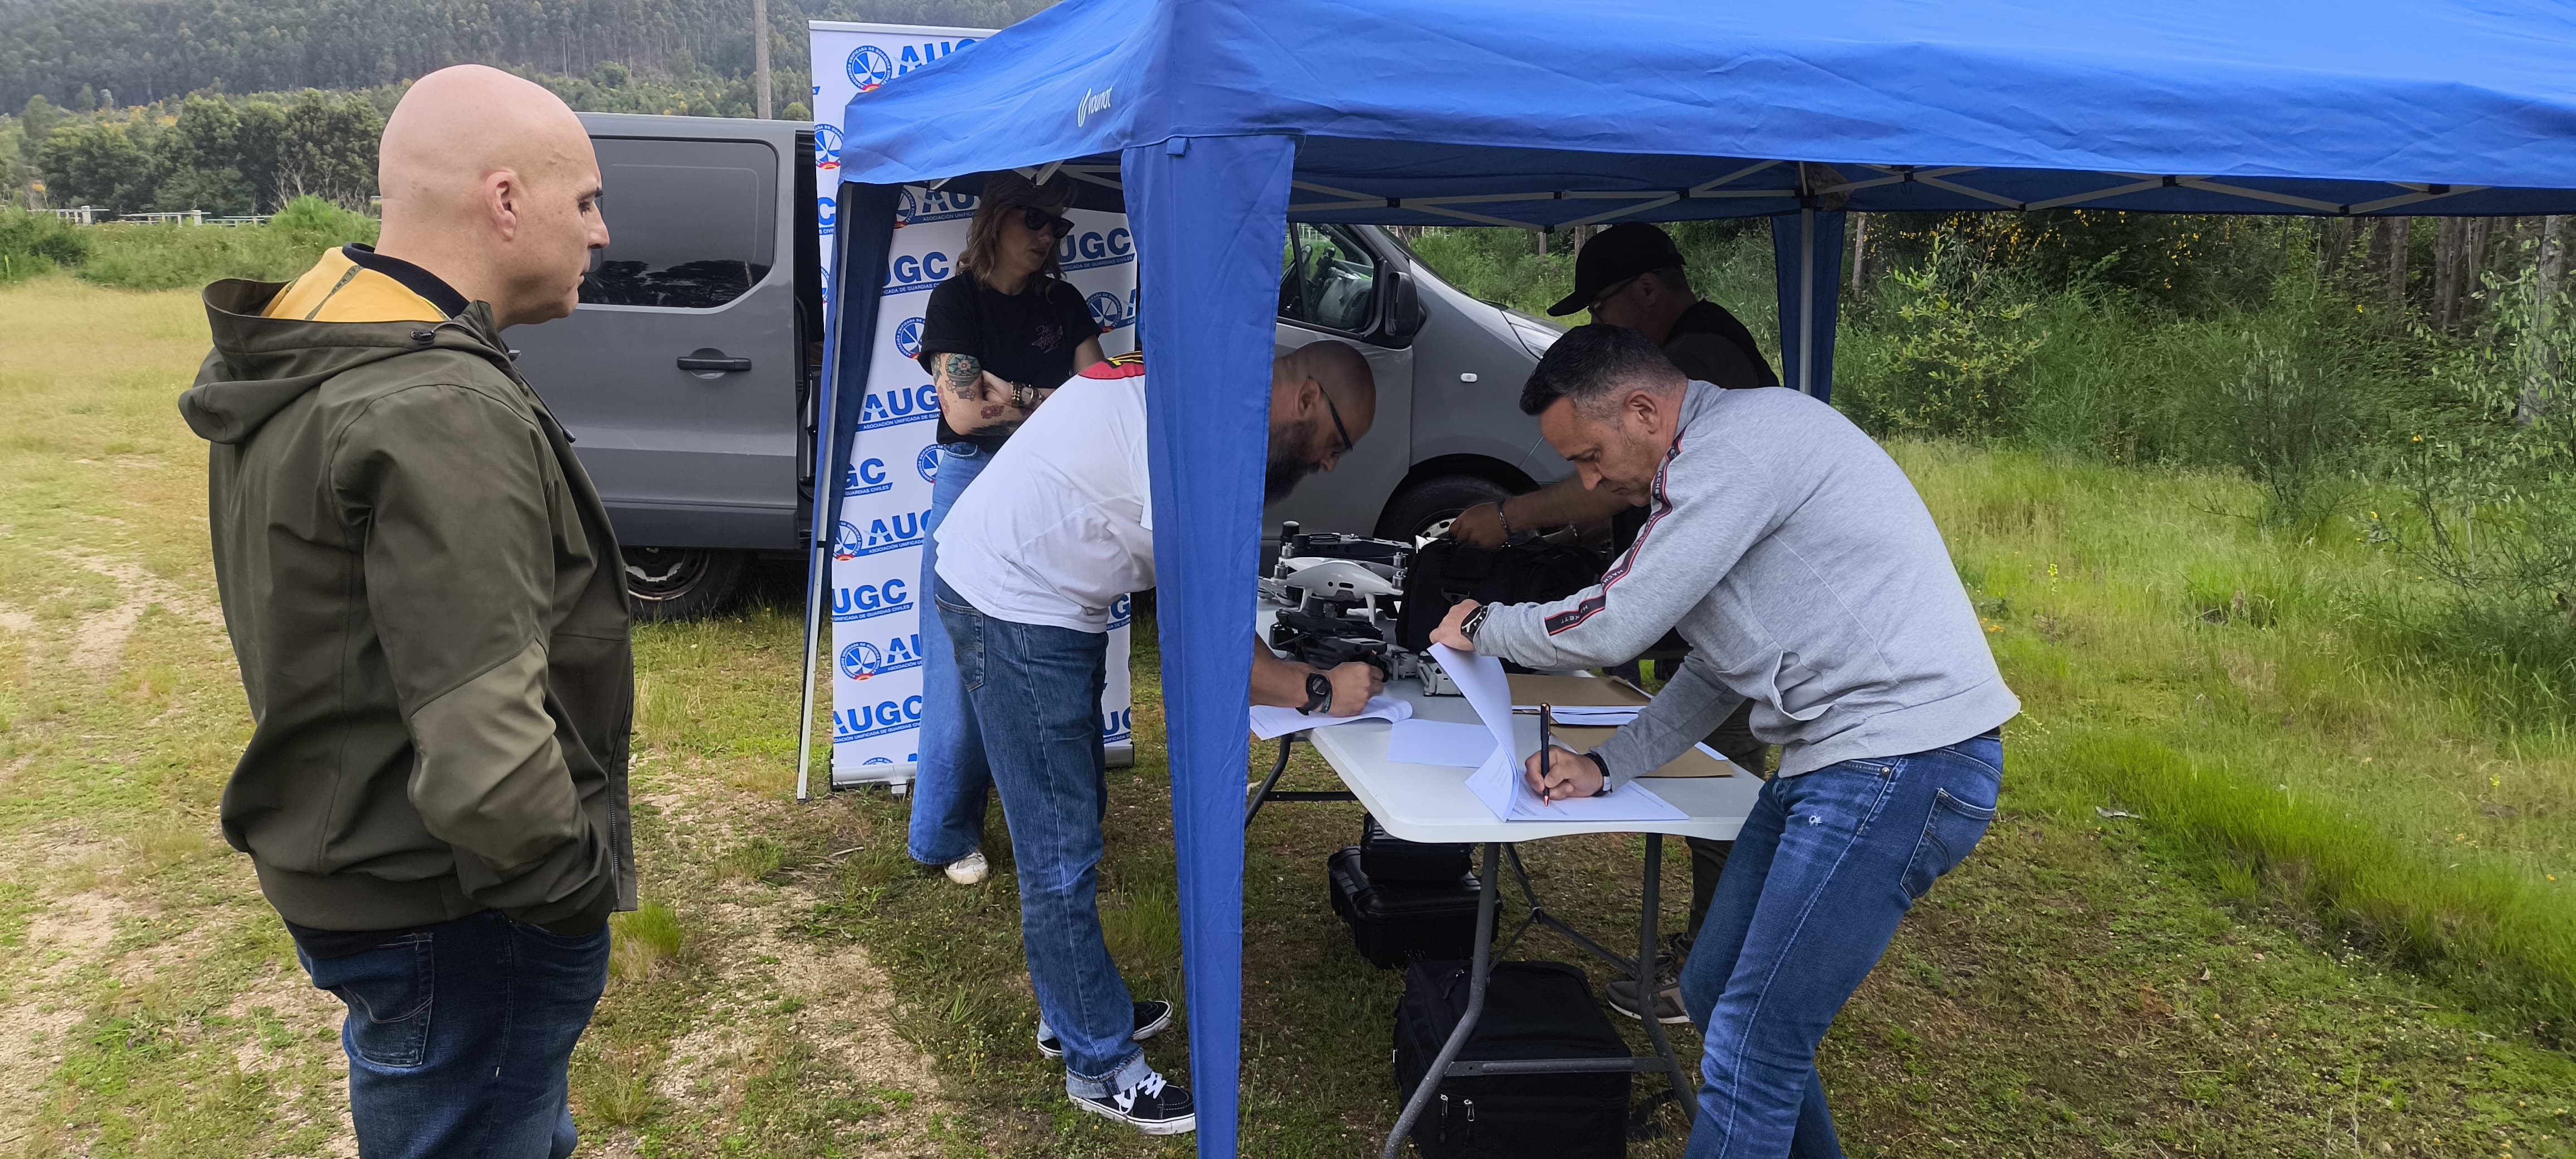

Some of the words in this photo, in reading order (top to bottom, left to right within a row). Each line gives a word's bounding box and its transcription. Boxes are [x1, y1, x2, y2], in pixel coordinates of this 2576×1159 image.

[898, 39, 977, 75] AU
[923, 192, 974, 213] AU
[1059, 228, 1130, 262] UGC
[886, 252, 949, 283] GC
[863, 384, 940, 421] AUG
[868, 509, 931, 546] AU
[1602, 569, 1623, 586] HACK
[832, 579, 906, 613] UGC
[1561, 605, 1588, 624] HKETT
[854, 731, 880, 739] UNIFICADA
[888, 724, 911, 732] GUARDIAS
